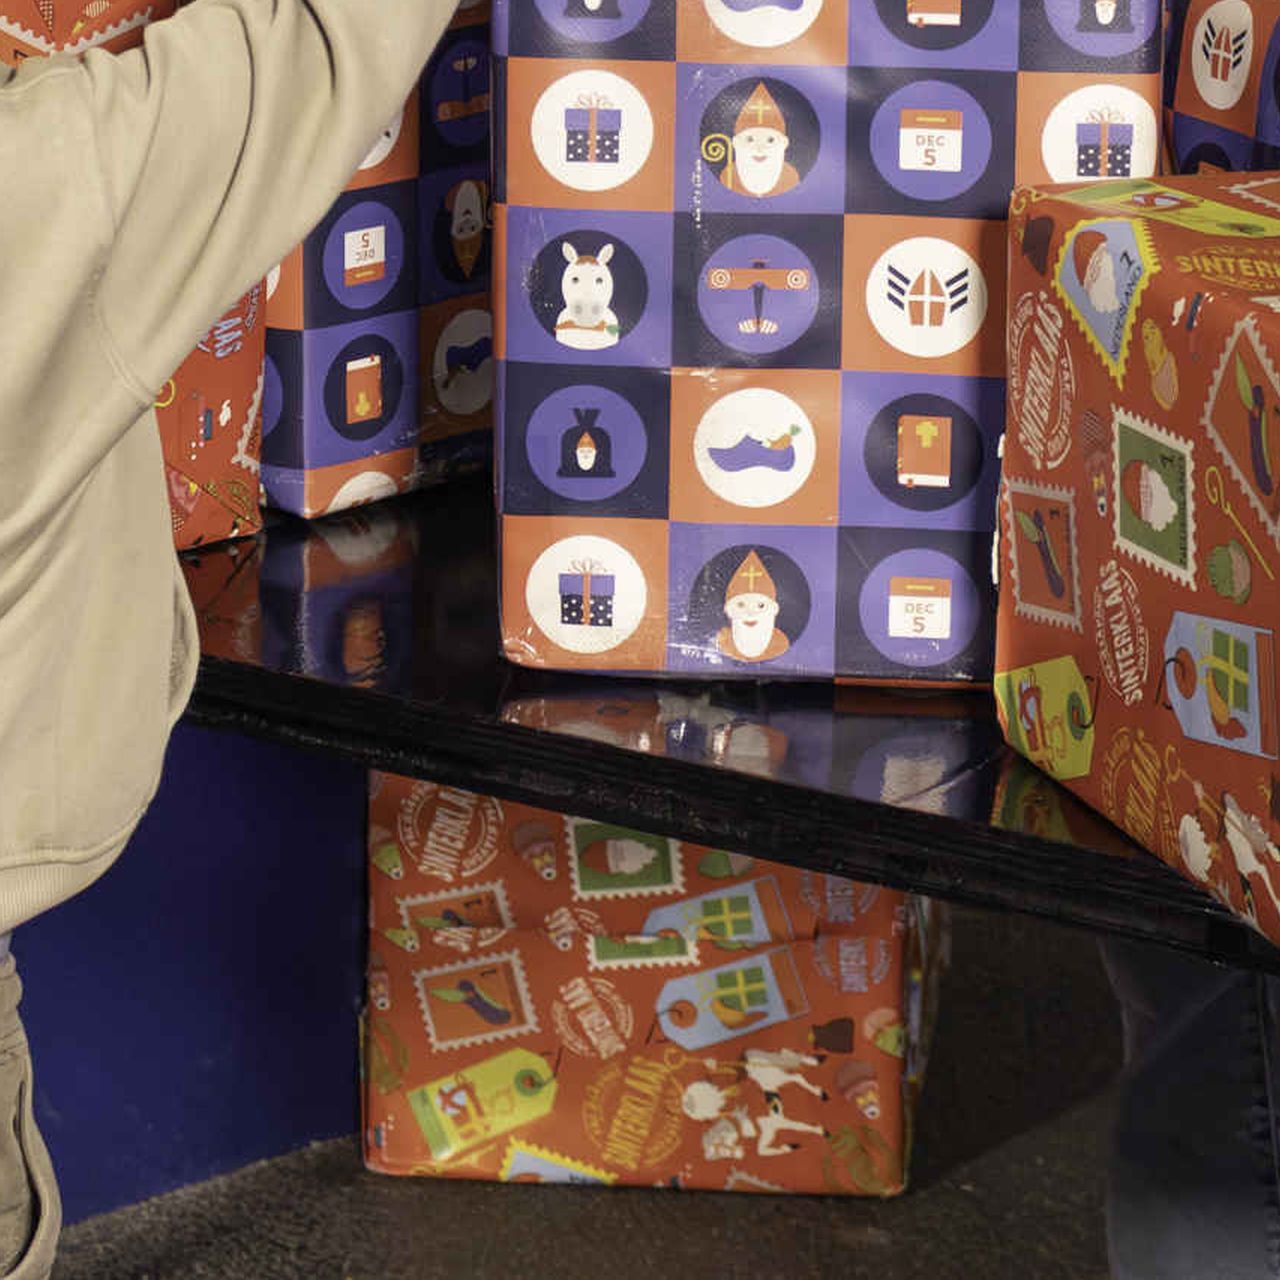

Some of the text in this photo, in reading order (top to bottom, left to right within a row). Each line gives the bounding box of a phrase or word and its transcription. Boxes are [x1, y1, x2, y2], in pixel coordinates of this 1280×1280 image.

[915, 134, 946, 147] DEC
[923, 147, 937, 167] 5
[361, 232, 371, 248] 5
[1120, 250, 1136, 269] 1
[904, 603, 936, 614] DEC
[912, 616, 926, 633] 5
[1100, 560, 1145, 707] SINTERKLAAS
